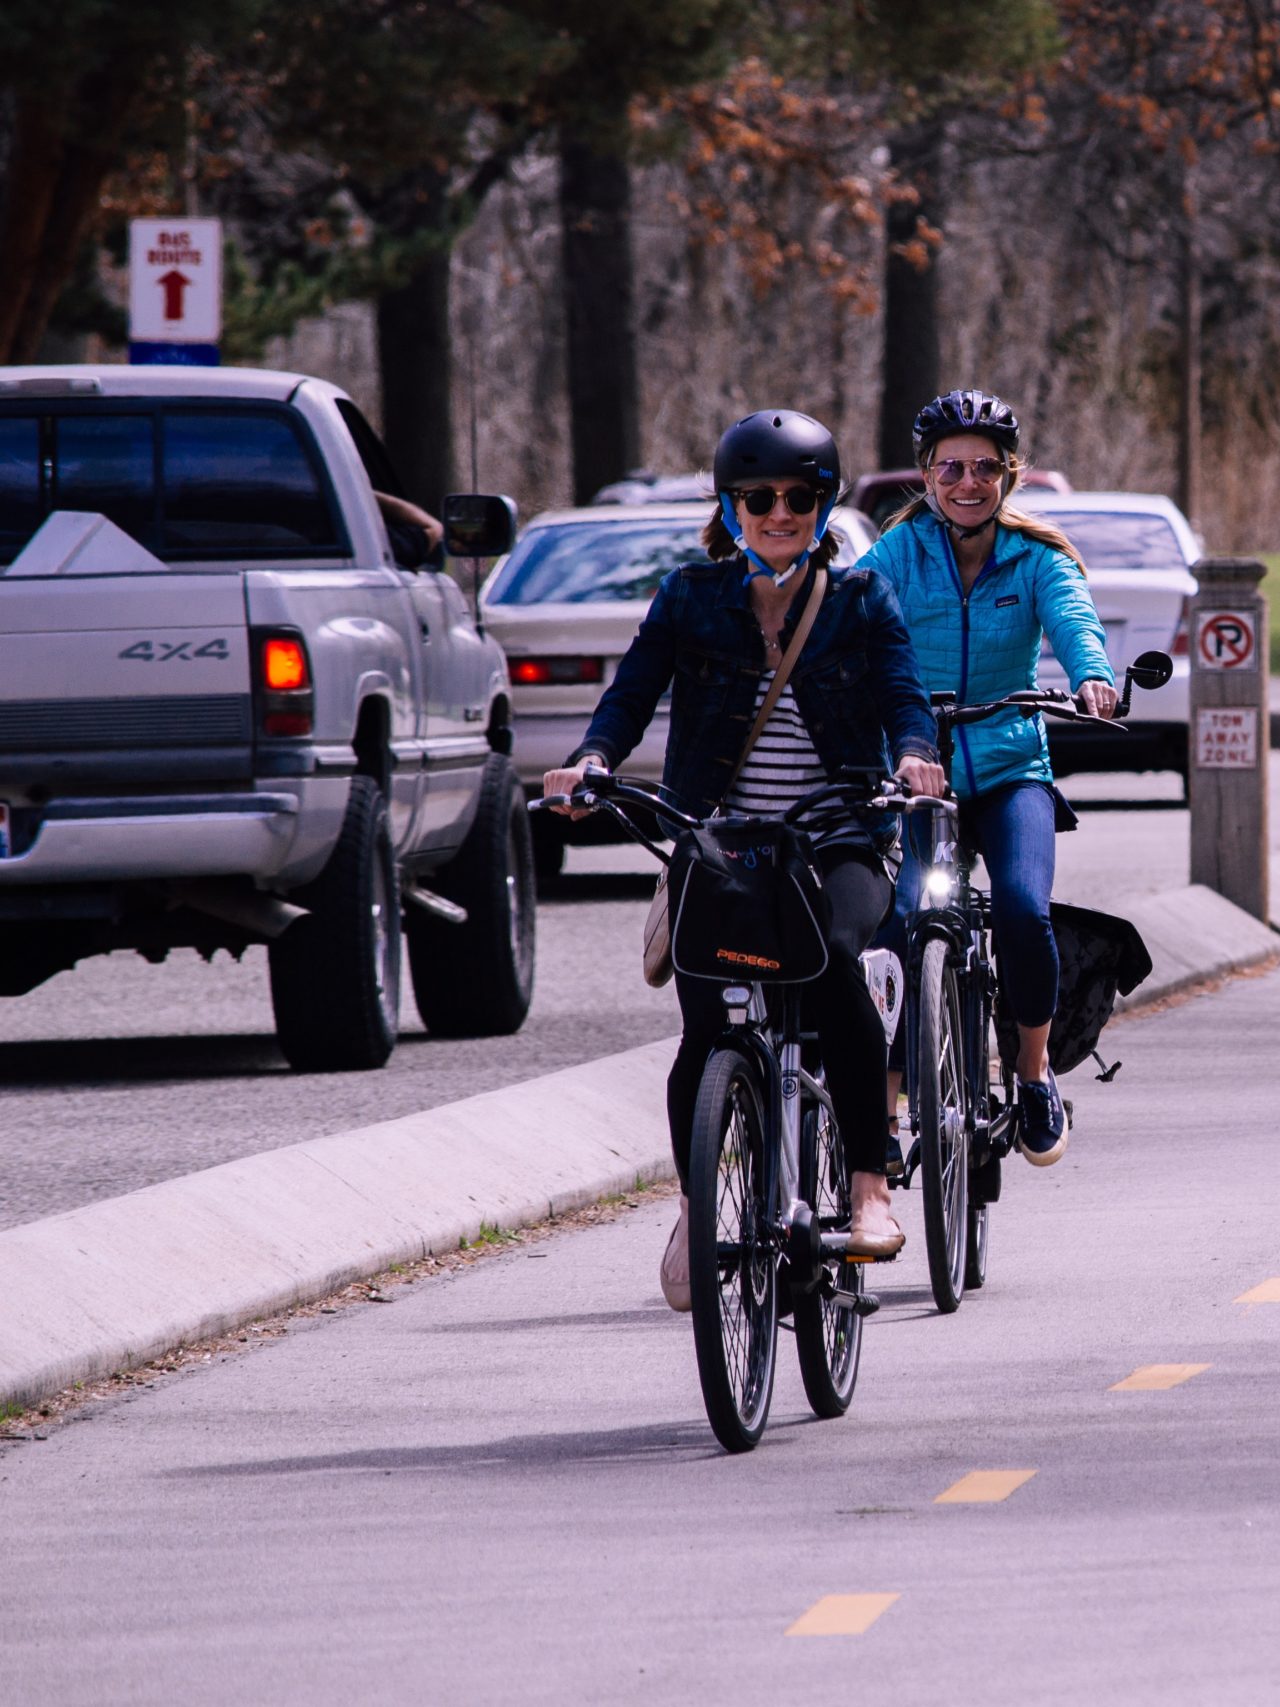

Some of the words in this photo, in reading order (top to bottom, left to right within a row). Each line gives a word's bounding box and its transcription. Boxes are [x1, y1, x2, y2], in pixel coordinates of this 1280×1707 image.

[157, 231, 191, 247] BUS
[147, 250, 203, 266] ROUTE
[1212, 714, 1243, 728] TOW
[1204, 732, 1250, 745] AWAY
[1204, 749, 1249, 763] ZONE
[717, 948, 780, 969] PEDEGO
